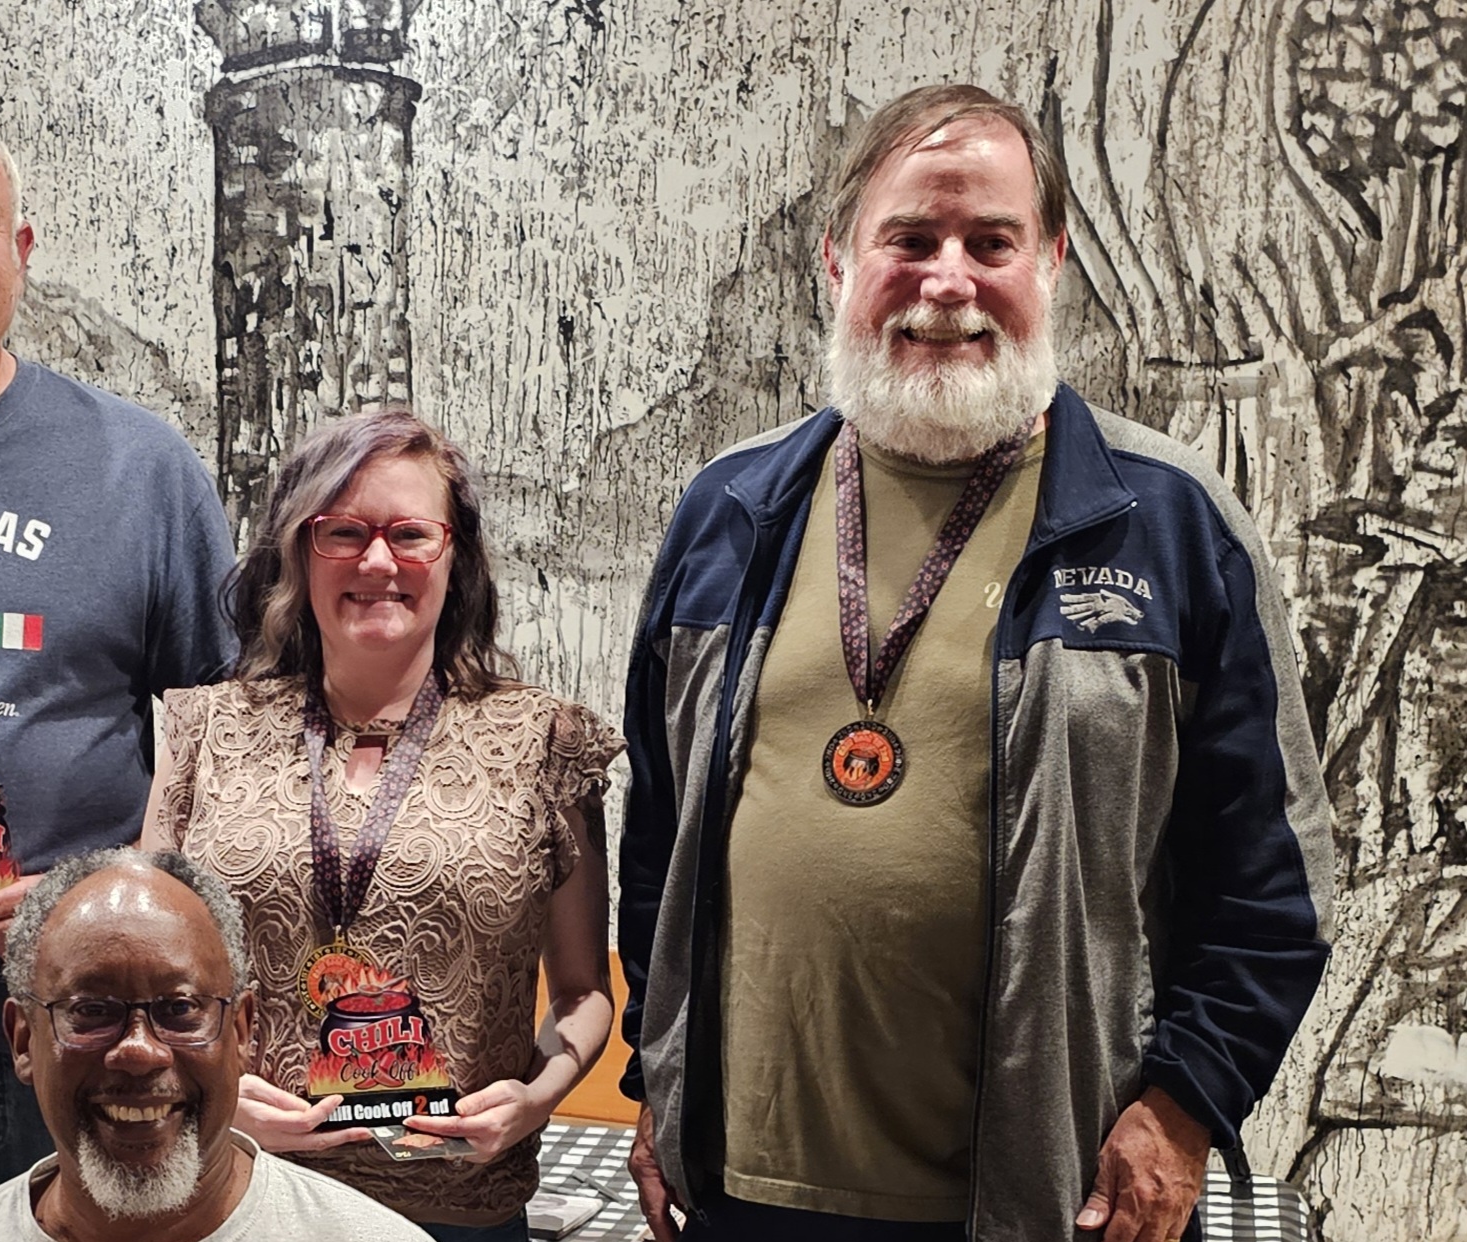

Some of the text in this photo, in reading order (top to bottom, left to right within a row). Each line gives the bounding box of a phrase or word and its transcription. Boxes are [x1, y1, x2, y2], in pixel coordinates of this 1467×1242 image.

[328, 1016, 425, 1057] CHILI
[340, 1060, 416, 1082] Cook Off
[353, 1103, 392, 1120] Cook
[392, 1100, 413, 1118] Off
